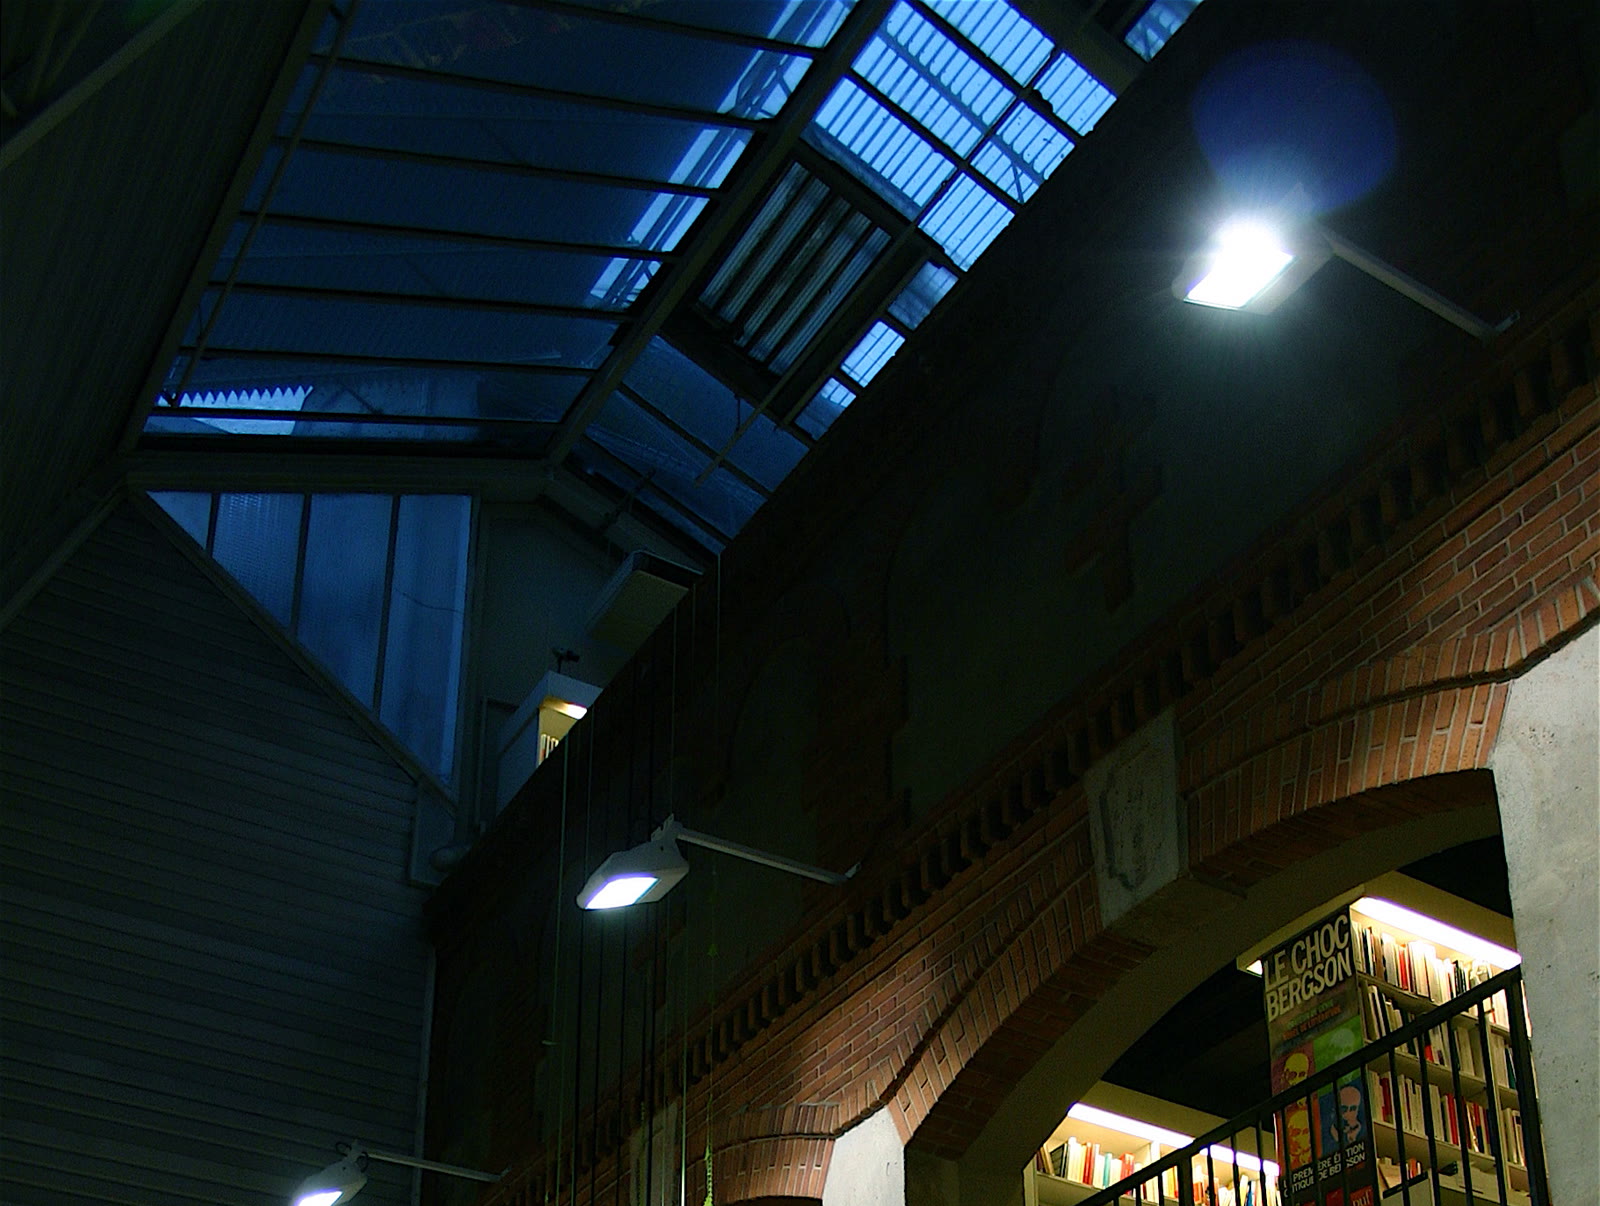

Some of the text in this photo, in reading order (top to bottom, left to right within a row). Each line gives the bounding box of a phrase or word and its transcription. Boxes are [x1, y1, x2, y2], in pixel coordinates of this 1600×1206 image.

[1263, 914, 1349, 992] LE CHOC
[1266, 947, 1352, 1022] BERGSON
